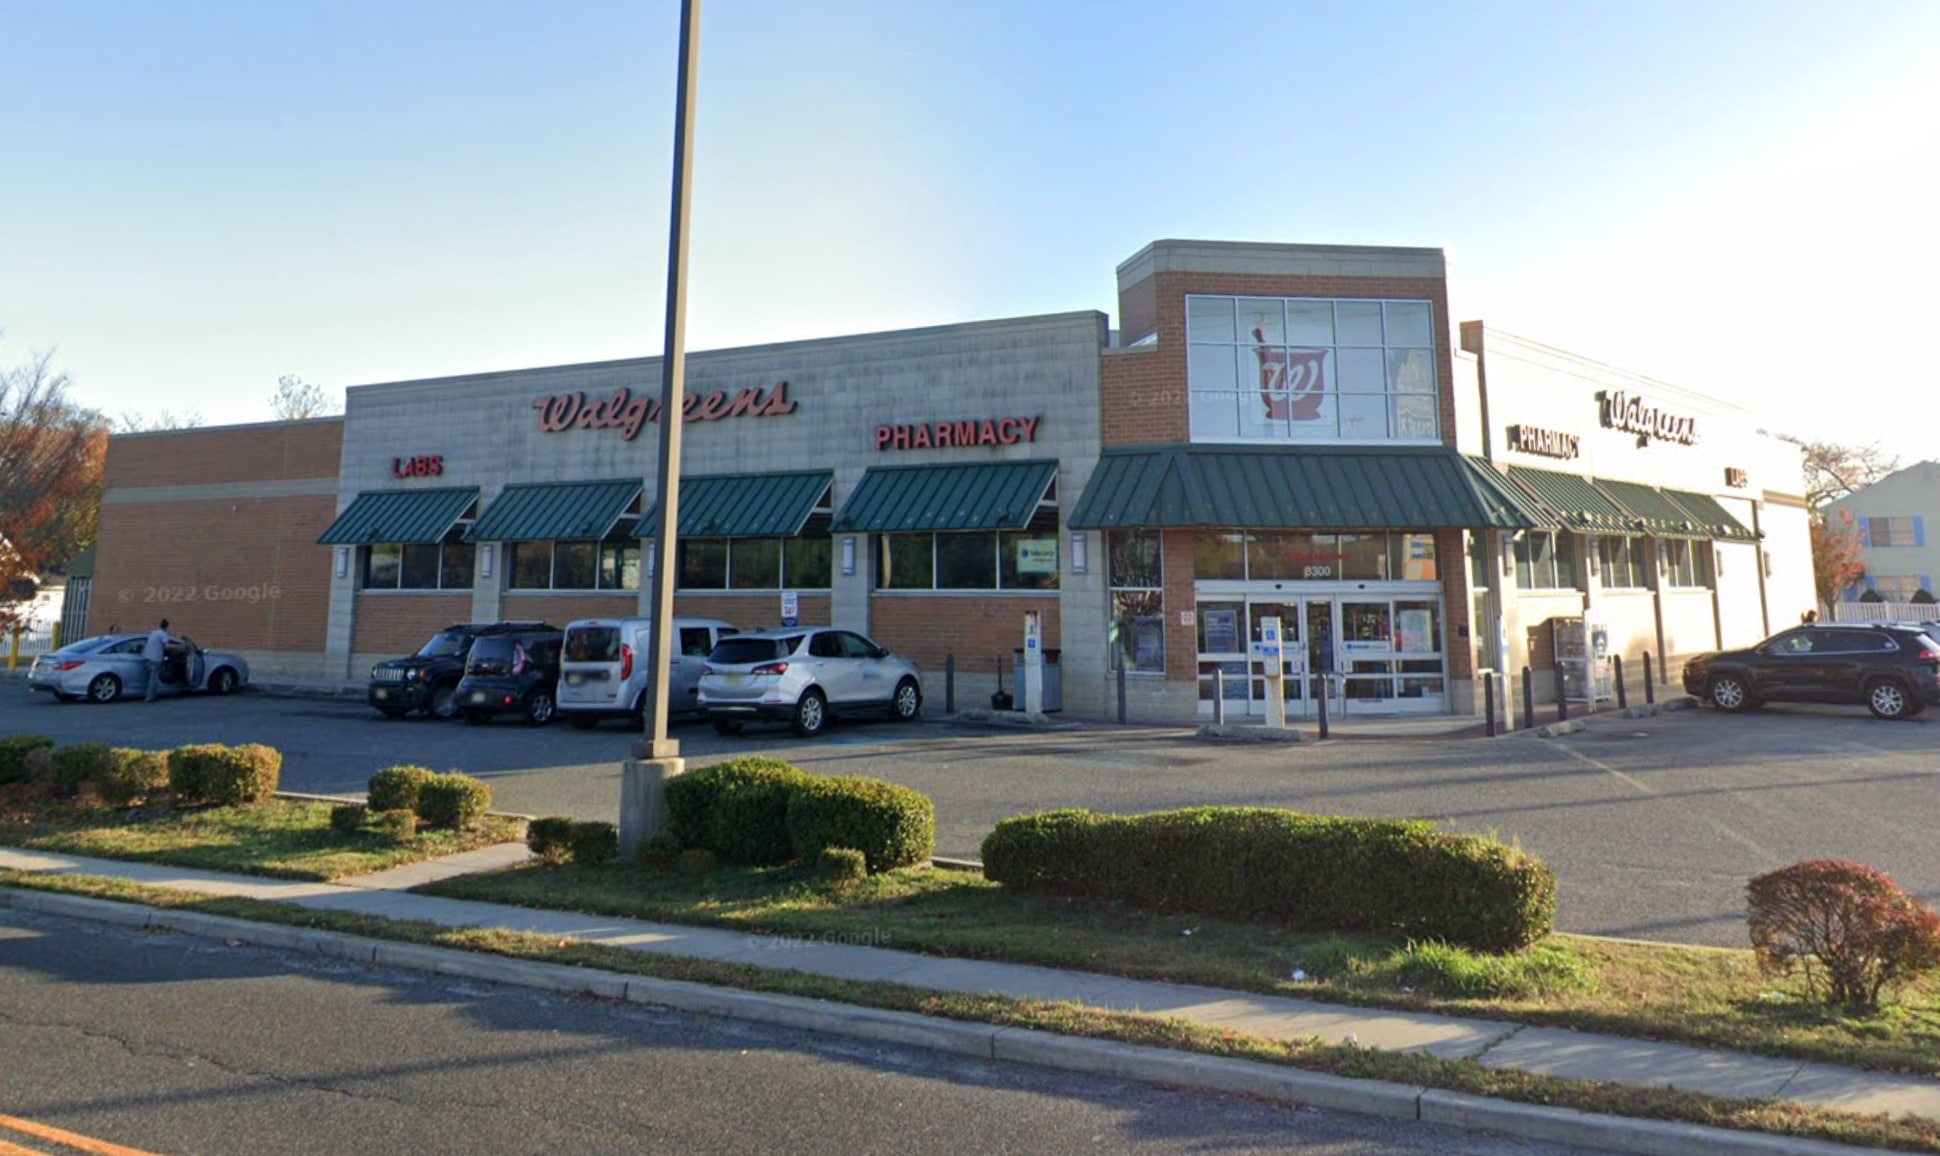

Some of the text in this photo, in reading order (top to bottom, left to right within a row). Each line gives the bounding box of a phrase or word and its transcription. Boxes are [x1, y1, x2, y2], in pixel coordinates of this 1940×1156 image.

[875, 415, 1040, 453] PHARMACY
[1595, 389, 1701, 449] Walgreen
[1507, 424, 1580, 460] PHARMACY
[392, 455, 443, 479] LABS
